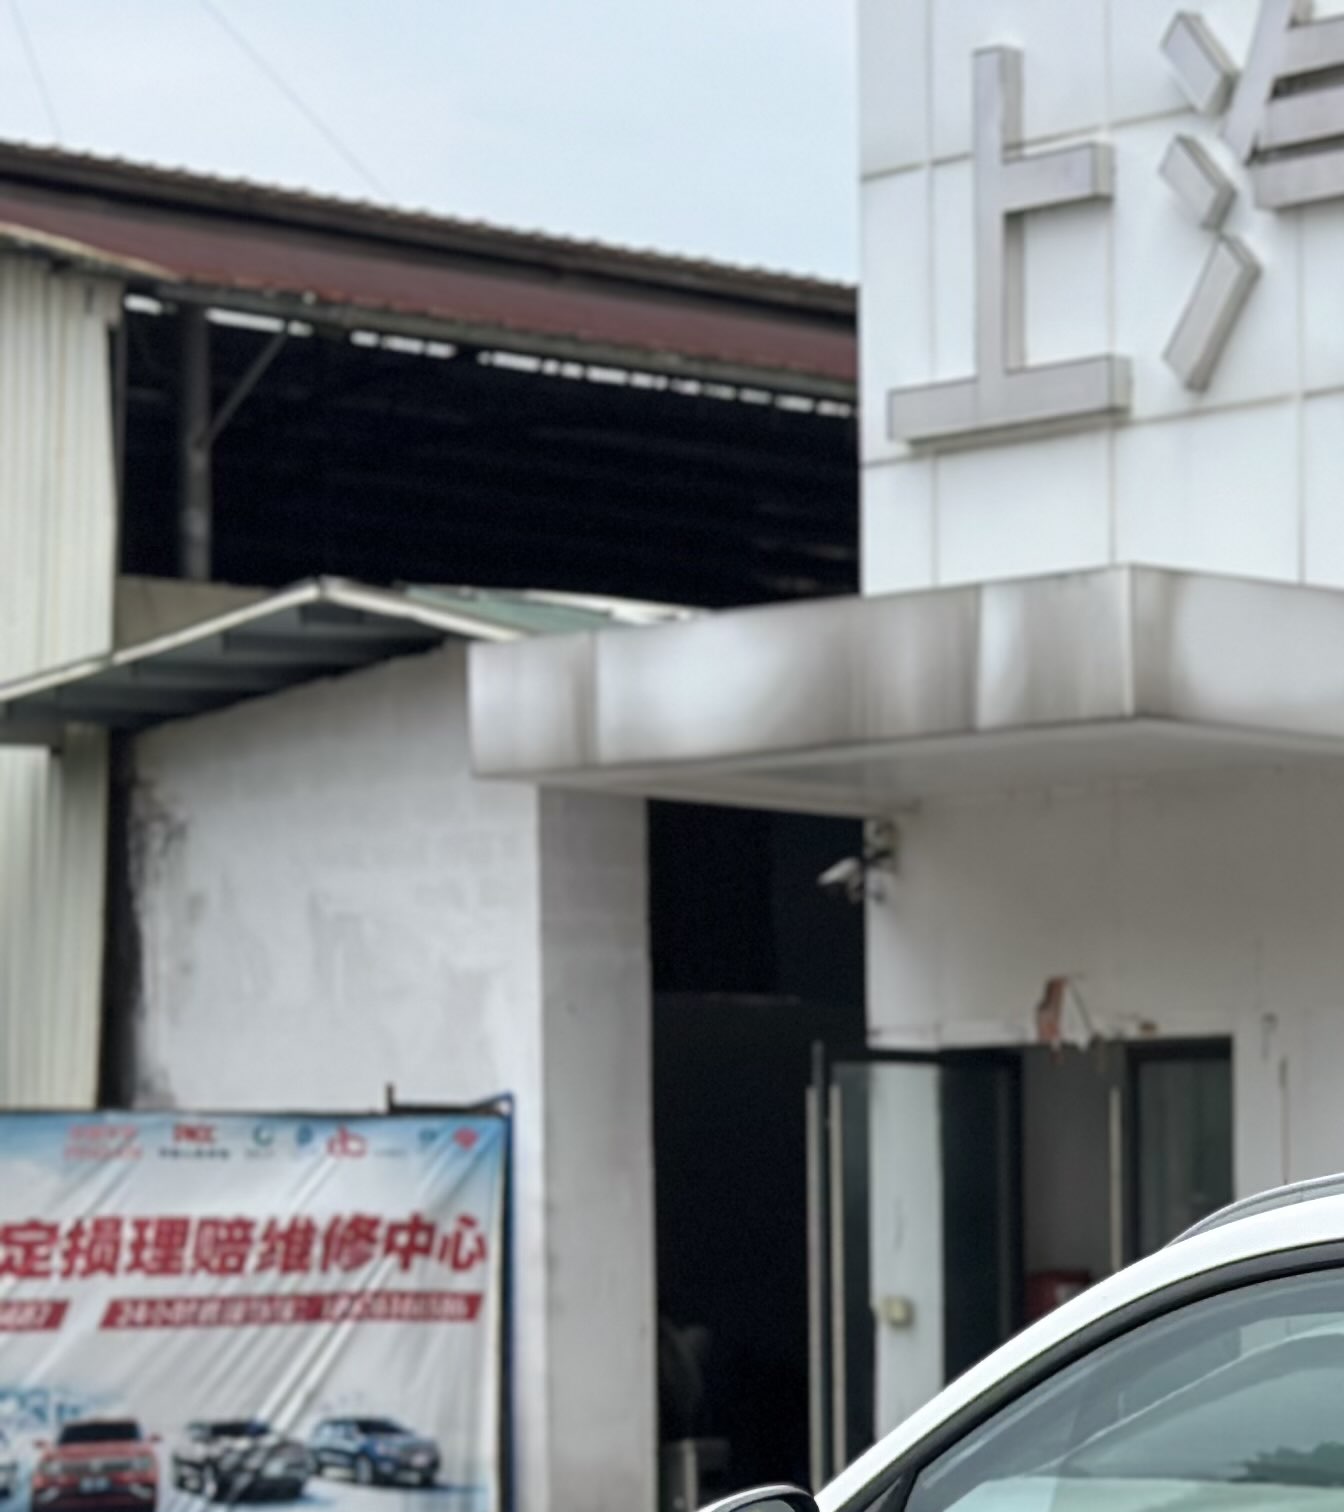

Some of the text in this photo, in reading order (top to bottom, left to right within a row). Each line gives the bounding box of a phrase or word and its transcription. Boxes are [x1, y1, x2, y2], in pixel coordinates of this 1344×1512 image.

[0, 1213, 487, 1279] 定损理赔维修中心
